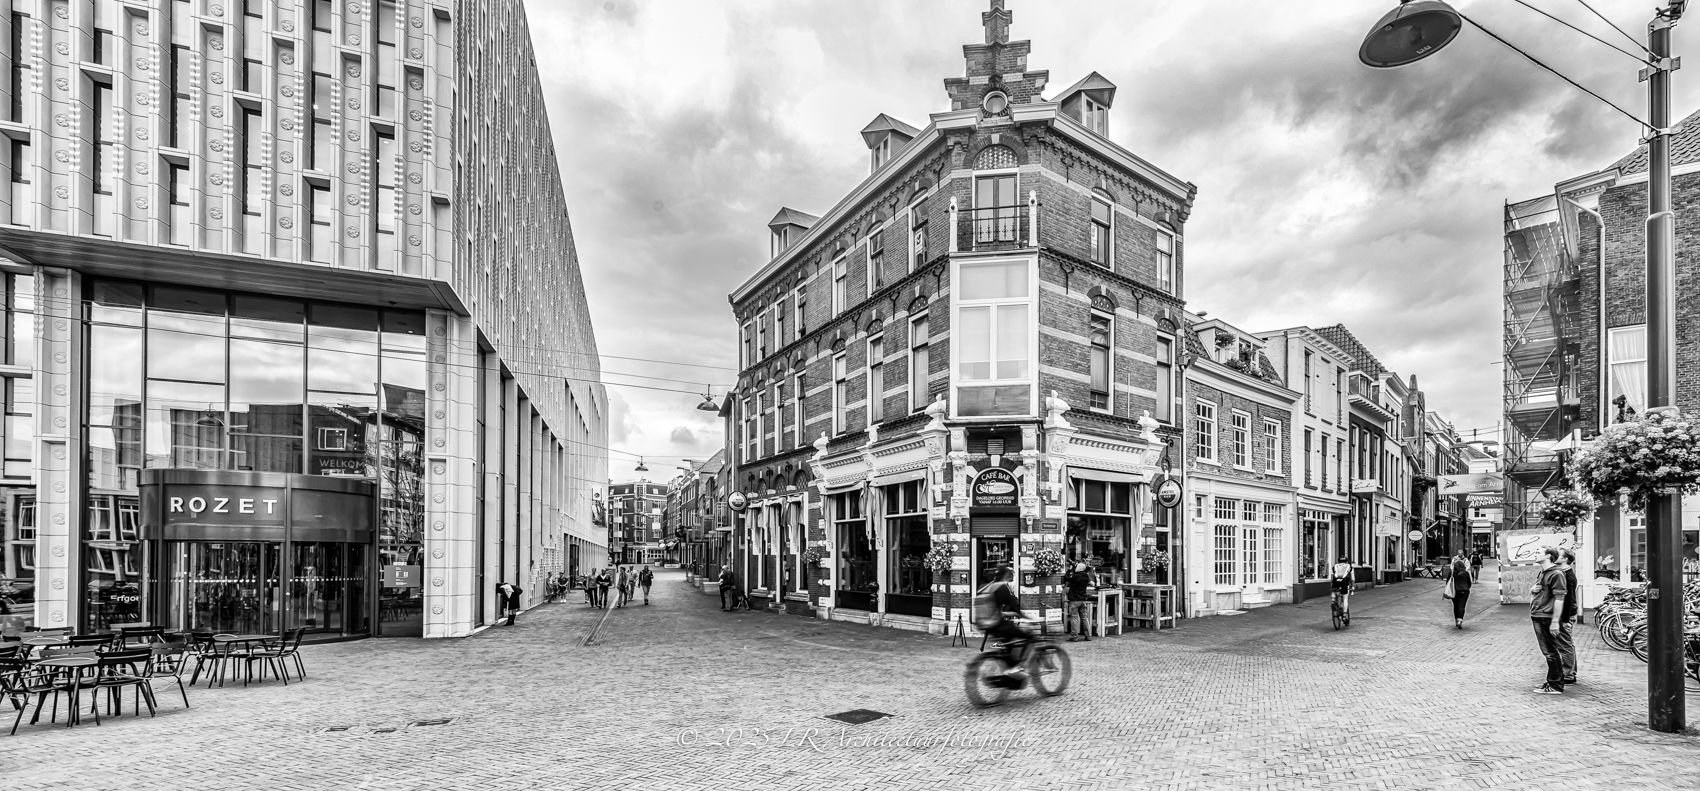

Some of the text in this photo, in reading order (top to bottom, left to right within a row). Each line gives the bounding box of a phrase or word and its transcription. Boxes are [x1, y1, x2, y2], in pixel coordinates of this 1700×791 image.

[320, 460, 364, 470] WELKOM
[981, 471, 1011, 481] CAFÉ BAR
[170, 496, 278, 514] ROZET
